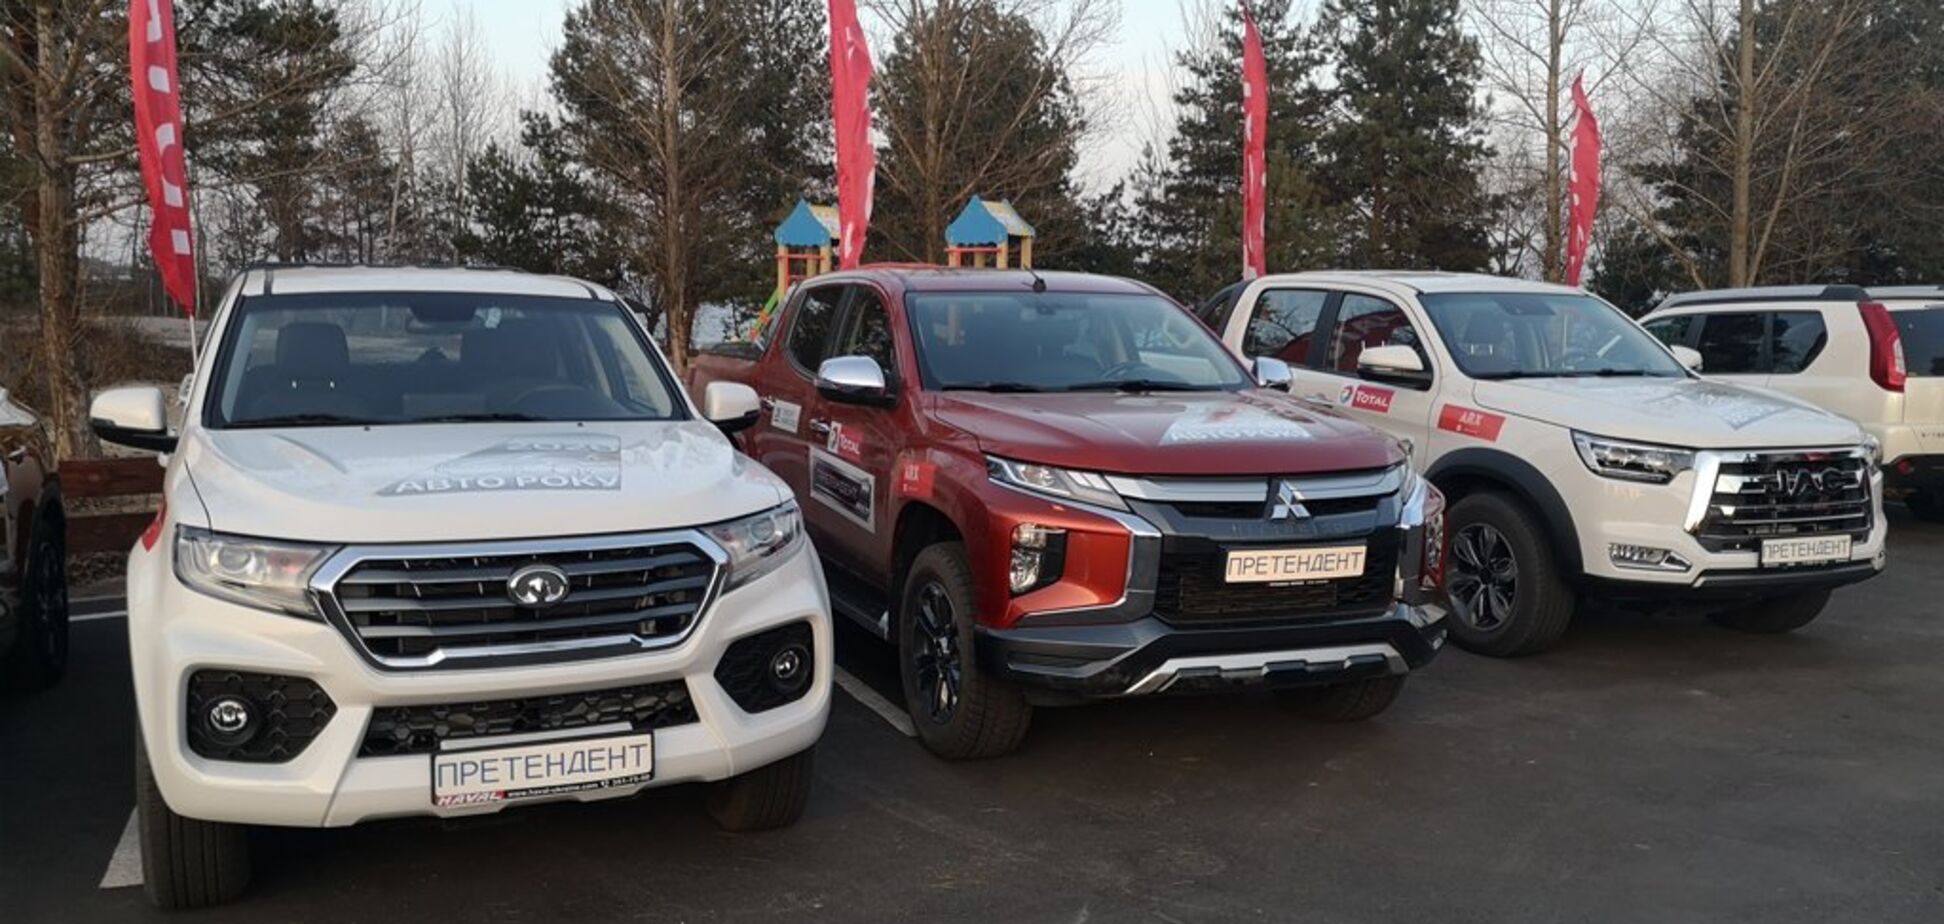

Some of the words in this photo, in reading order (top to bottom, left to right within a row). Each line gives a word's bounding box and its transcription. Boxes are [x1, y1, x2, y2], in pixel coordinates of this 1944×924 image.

[1356, 391, 1389, 407] TOTAL
[1459, 411, 1483, 426] ARX
[839, 434, 861, 454] TOTAL
[395, 477, 504, 494] АВТО
[515, 475, 618, 488] РОКУ
[1765, 467, 1846, 495] JAC
[1763, 539, 1849, 559] ПРЕТЕНДЕНТ
[1228, 551, 1363, 576] ПРЕТЕНДЕНТ
[438, 743, 648, 788] ПРЕТЕНДЕНТ
[437, 791, 501, 806] HAVAL
